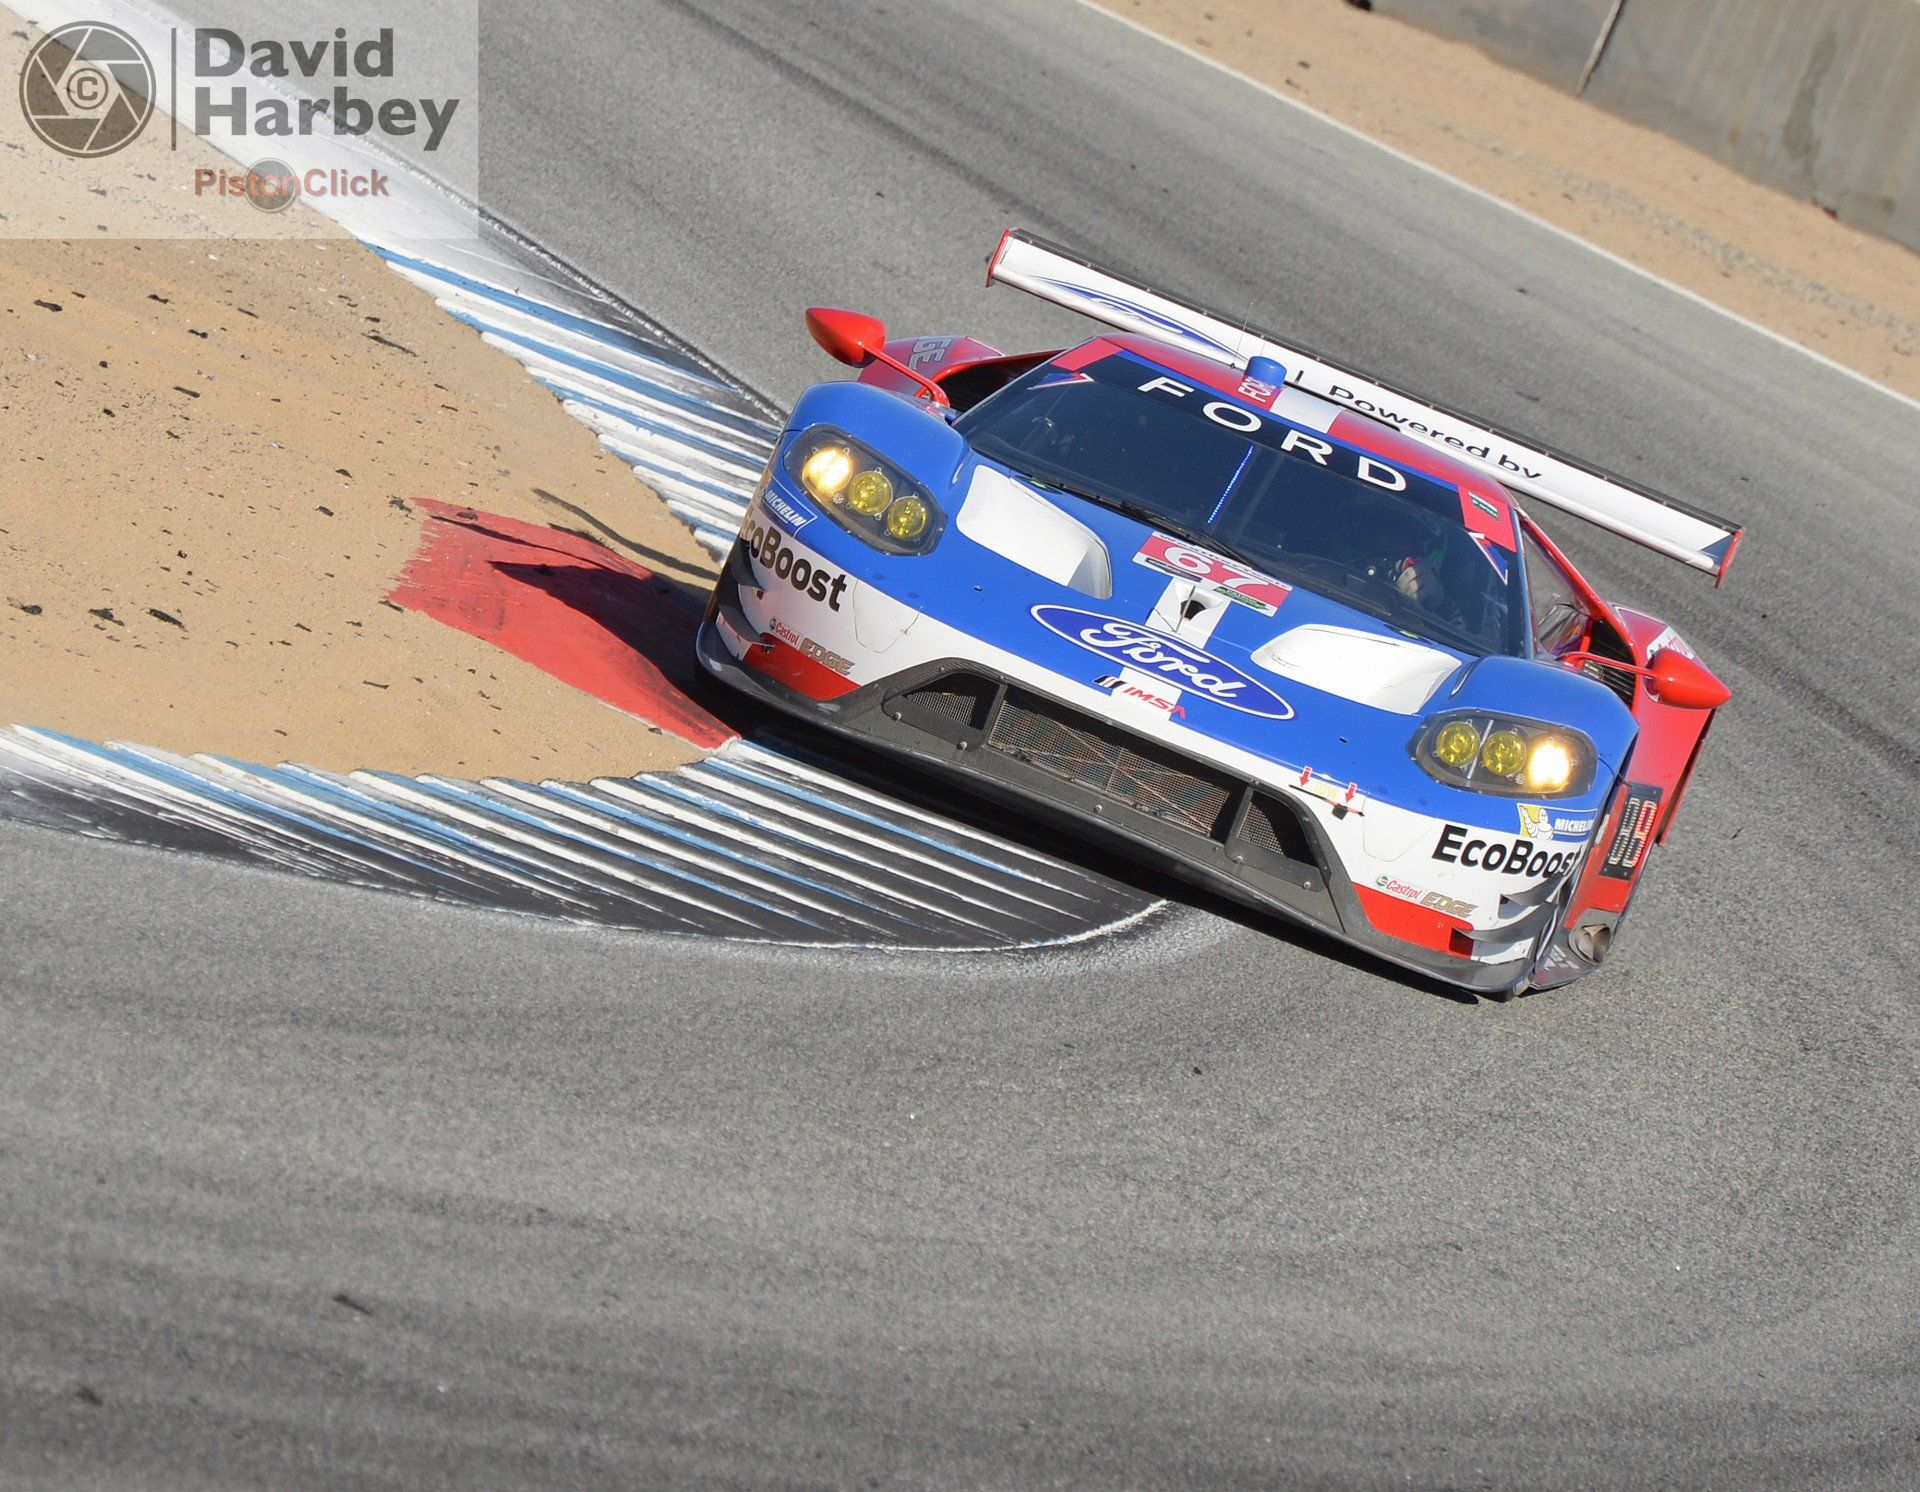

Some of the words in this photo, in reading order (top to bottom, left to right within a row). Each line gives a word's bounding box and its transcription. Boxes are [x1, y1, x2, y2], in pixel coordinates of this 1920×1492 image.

[1138, 376, 1406, 492] FORD
[1329, 384, 1491, 460] Powered
[1496, 454, 1543, 479] by
[764, 490, 808, 527] MICHELIN
[1164, 546, 1270, 589] 67
[775, 621, 799, 646] Castrol
[800, 637, 856, 677] EDGE
[1080, 622, 1247, 698] Ford
[1123, 686, 1187, 720] IMSA
[1386, 879, 1422, 900] Castrol
[1420, 891, 1479, 919] EDGE
